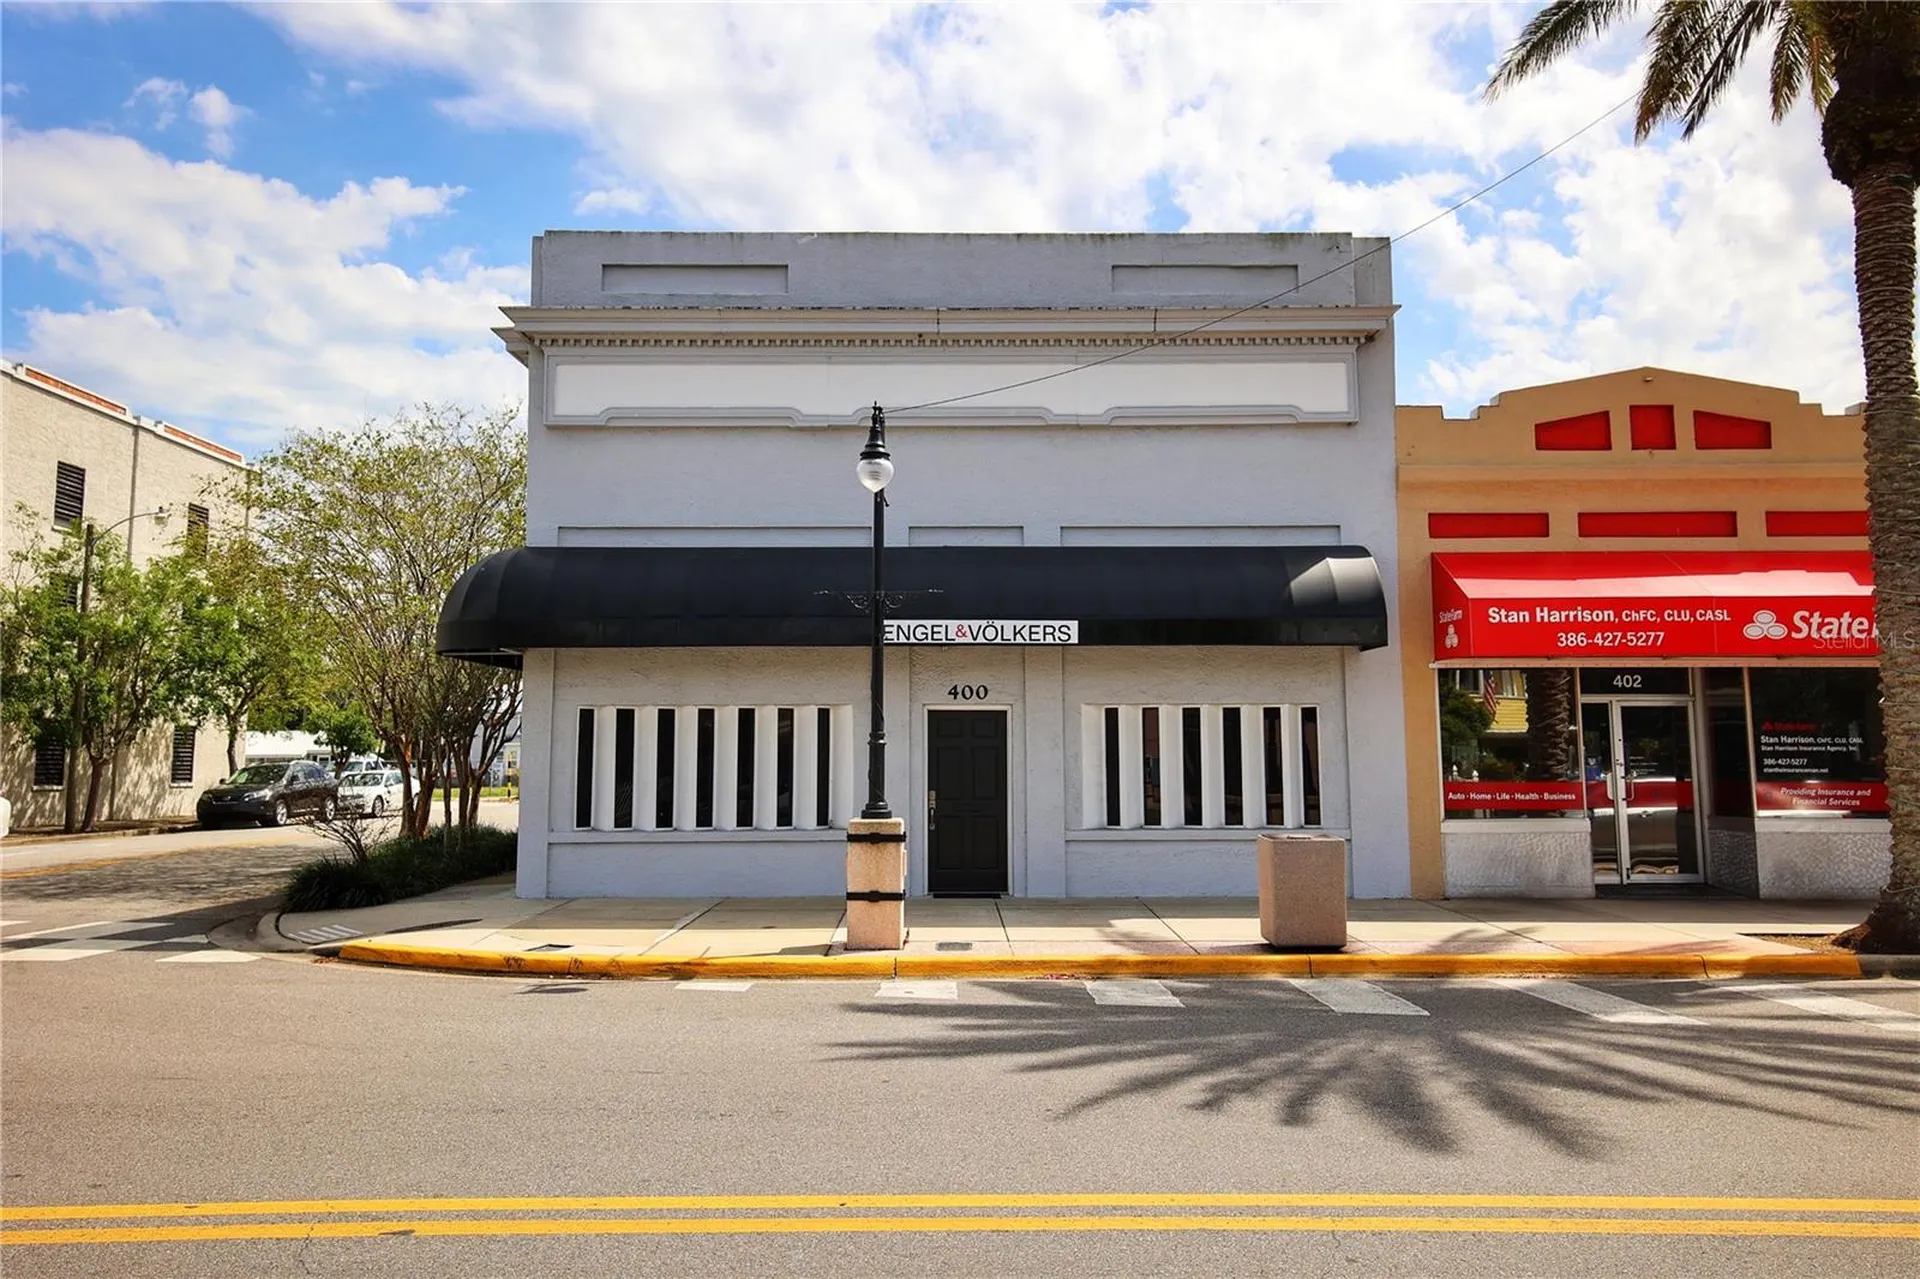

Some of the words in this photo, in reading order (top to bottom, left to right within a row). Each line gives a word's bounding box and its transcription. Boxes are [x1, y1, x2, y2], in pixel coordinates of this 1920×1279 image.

[1488, 607, 1529, 623] Stan
[1536, 607, 1618, 623] Harrison,
[1622, 609, 1660, 623] ChFC,
[1664, 609, 1694, 623] CLU,
[1696, 609, 1731, 622] CASL
[884, 620, 1071, 643] ENGEL&VÖLKERS
[1791, 610, 1879, 640] State
[1557, 632, 1665, 647] 386-427-5277
[1613, 674, 1642, 688] 402
[948, 684, 989, 700] 400
[1448, 792, 1465, 800] Auto
[1470, 792, 1491, 800] Home
[1496, 792, 1510, 800] Life
[1515, 792, 1539, 800] Health
[1544, 792, 1576, 800] Business
[1780, 787, 1816, 796] Providing
[1817, 788, 1854, 796] Insurance
[1856, 788, 1871, 796] and
[1828, 798, 1860, 806] Services
